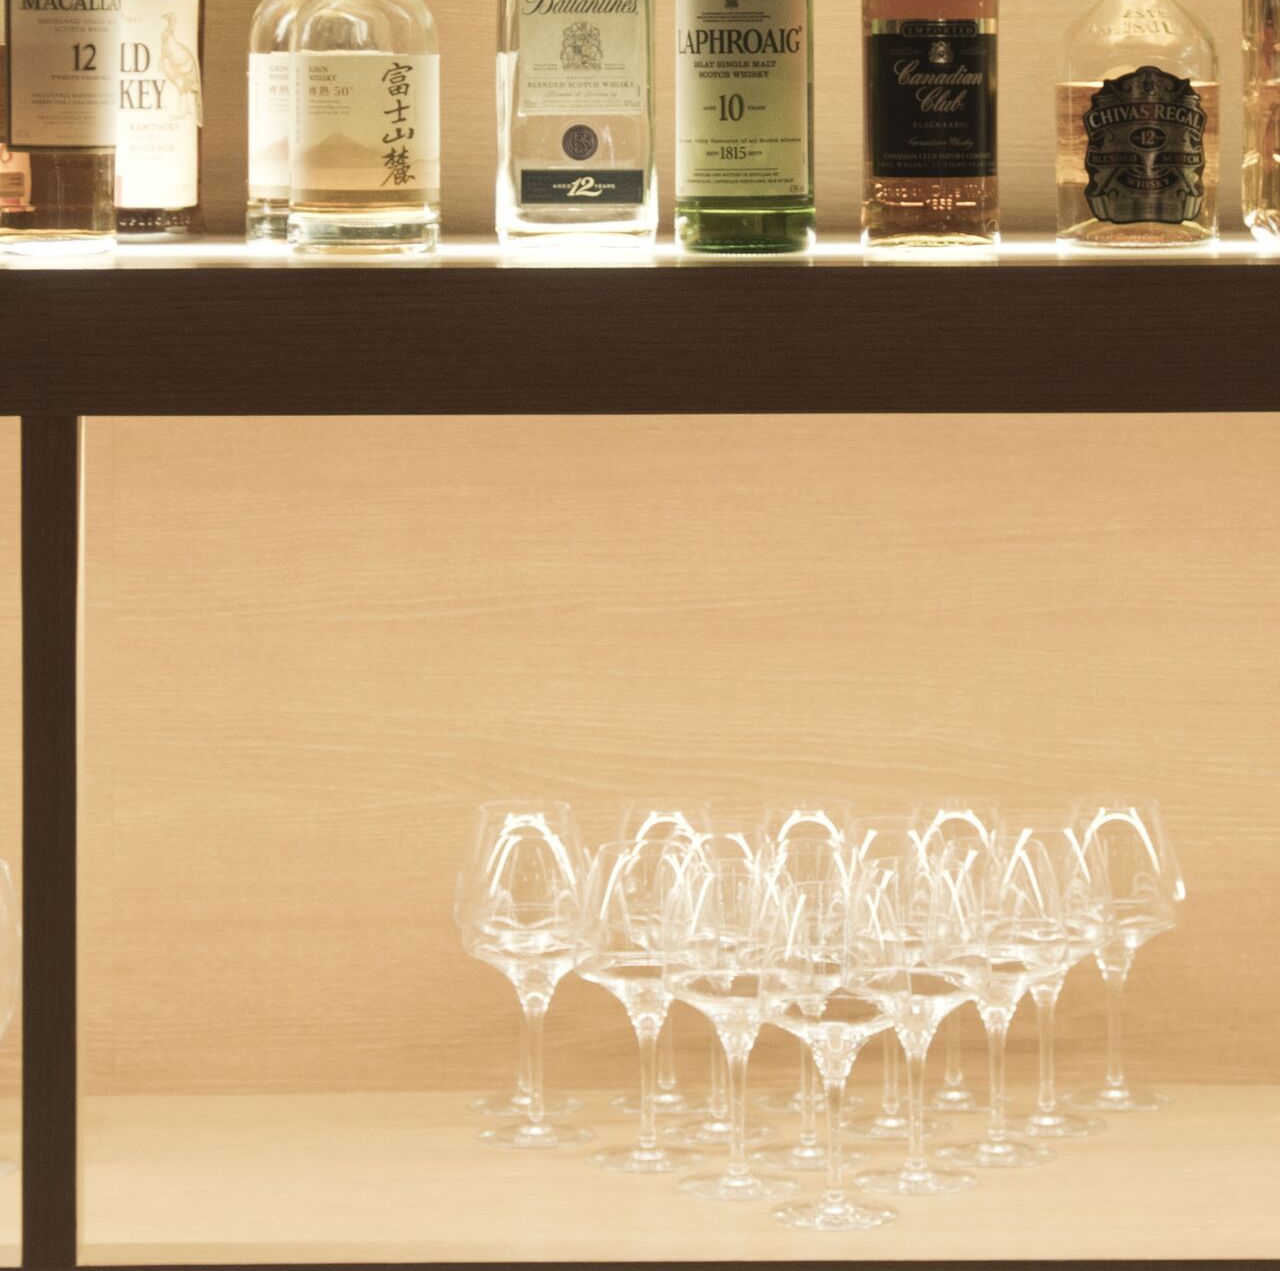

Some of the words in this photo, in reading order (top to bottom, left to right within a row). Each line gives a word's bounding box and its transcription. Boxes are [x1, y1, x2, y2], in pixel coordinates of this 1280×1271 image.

[679, 29, 800, 55] LAPHROAIG
[71, 43, 98, 71] 12
[120, 42, 151, 73] LD
[751, 60, 777, 68] MALT
[893, 59, 983, 85] Canadian
[120, 79, 167, 110] KEY
[718, 93, 746, 122] 10
[915, 87, 967, 113] Club
[379, 62, 417, 187] 富士山麓
[1089, 104, 1149, 129] CHIVAS
[1153, 104, 1201, 129] REGAL
[1140, 130, 1155, 145] 12
[719, 146, 748, 160] 1815
[566, 176, 603, 197] 12
